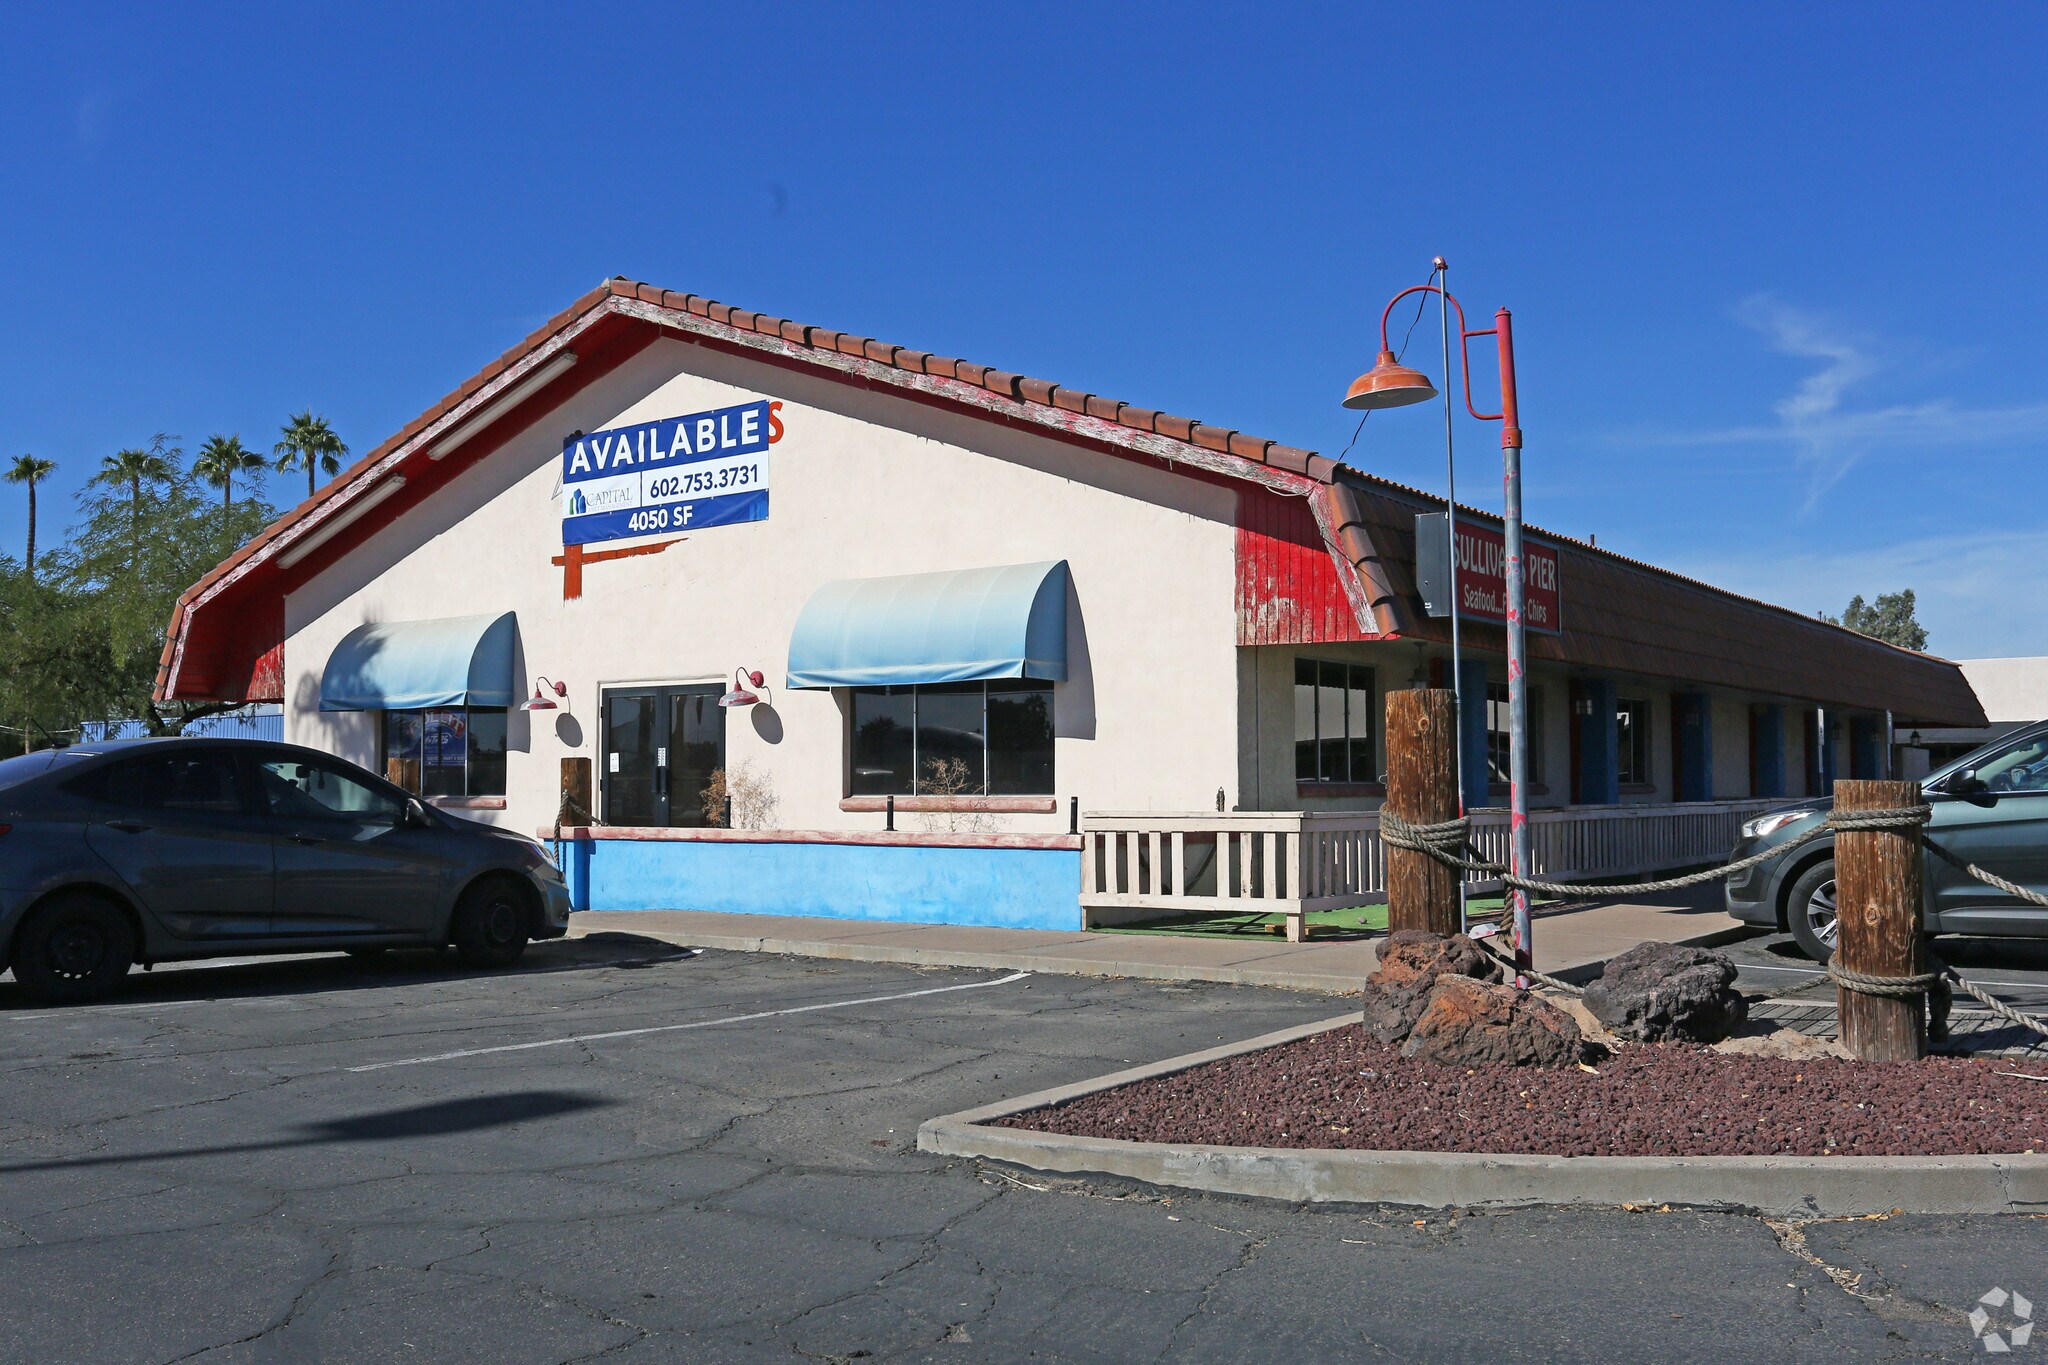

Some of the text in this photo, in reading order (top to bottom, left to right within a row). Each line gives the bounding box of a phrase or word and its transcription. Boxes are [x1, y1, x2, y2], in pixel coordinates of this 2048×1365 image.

[569, 409, 760, 475] AVAILABLE
[650, 464, 758, 498] 602.753.3731
[586, 487, 634, 507] CAPITAL
[628, 505, 693, 532] 4050 SF
[1529, 554, 1557, 593] PIER
[1527, 598, 1547, 624] Chips
